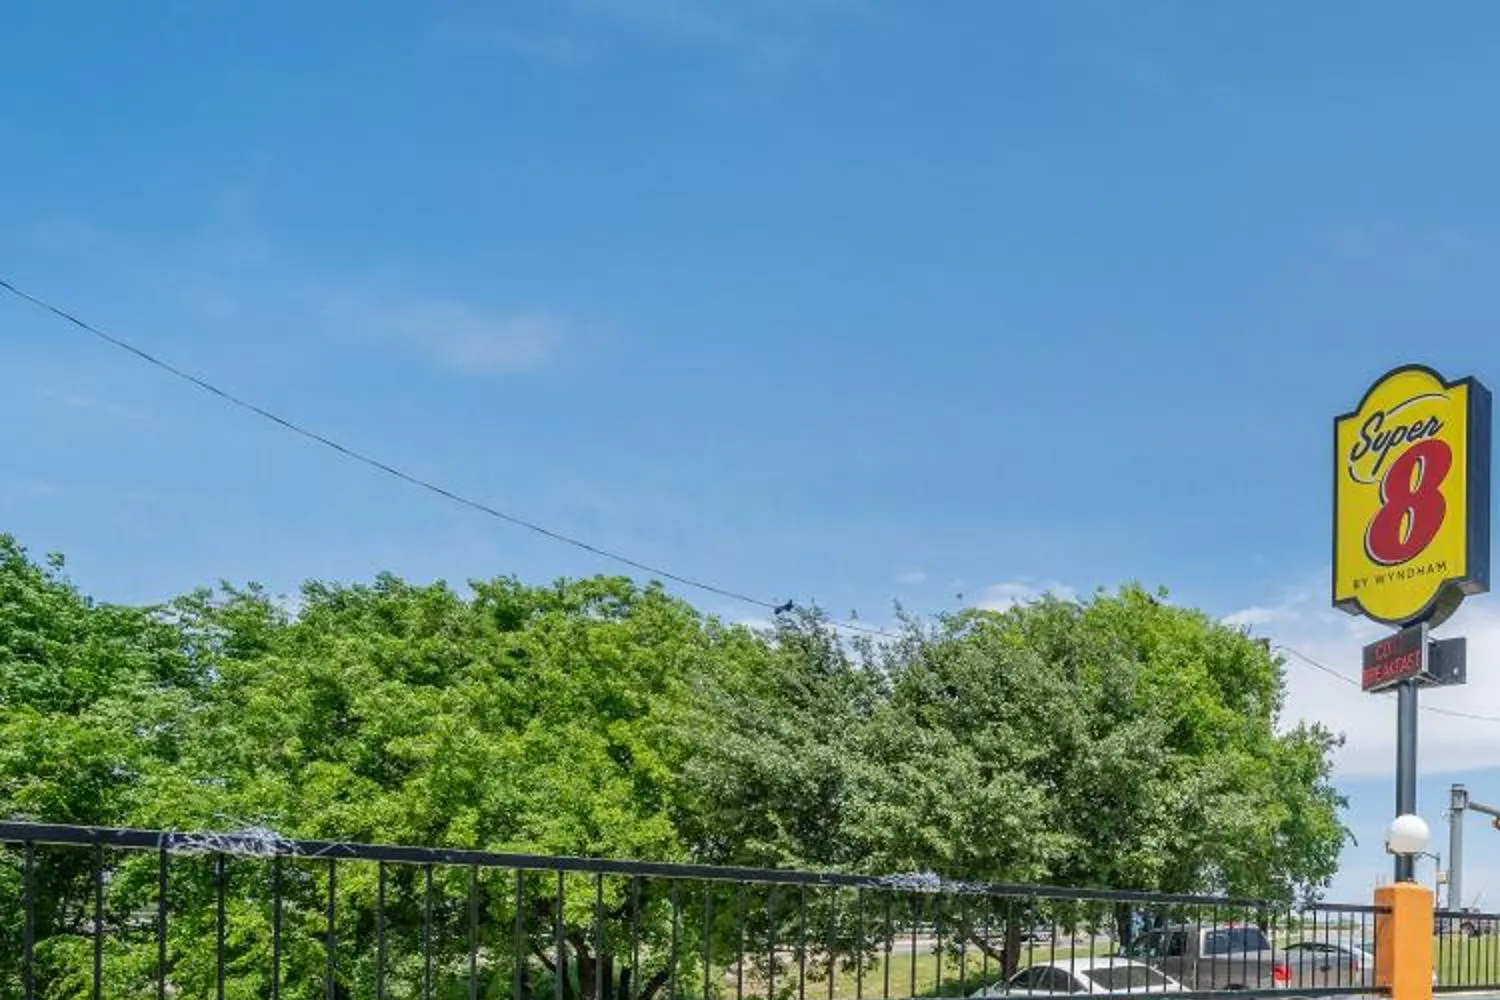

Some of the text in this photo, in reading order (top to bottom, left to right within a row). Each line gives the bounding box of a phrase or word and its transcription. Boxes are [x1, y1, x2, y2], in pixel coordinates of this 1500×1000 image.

[1350, 410, 1444, 477] Super
[1363, 437, 1453, 567] 8
[1353, 561, 1447, 590] BY WYNDHAM
